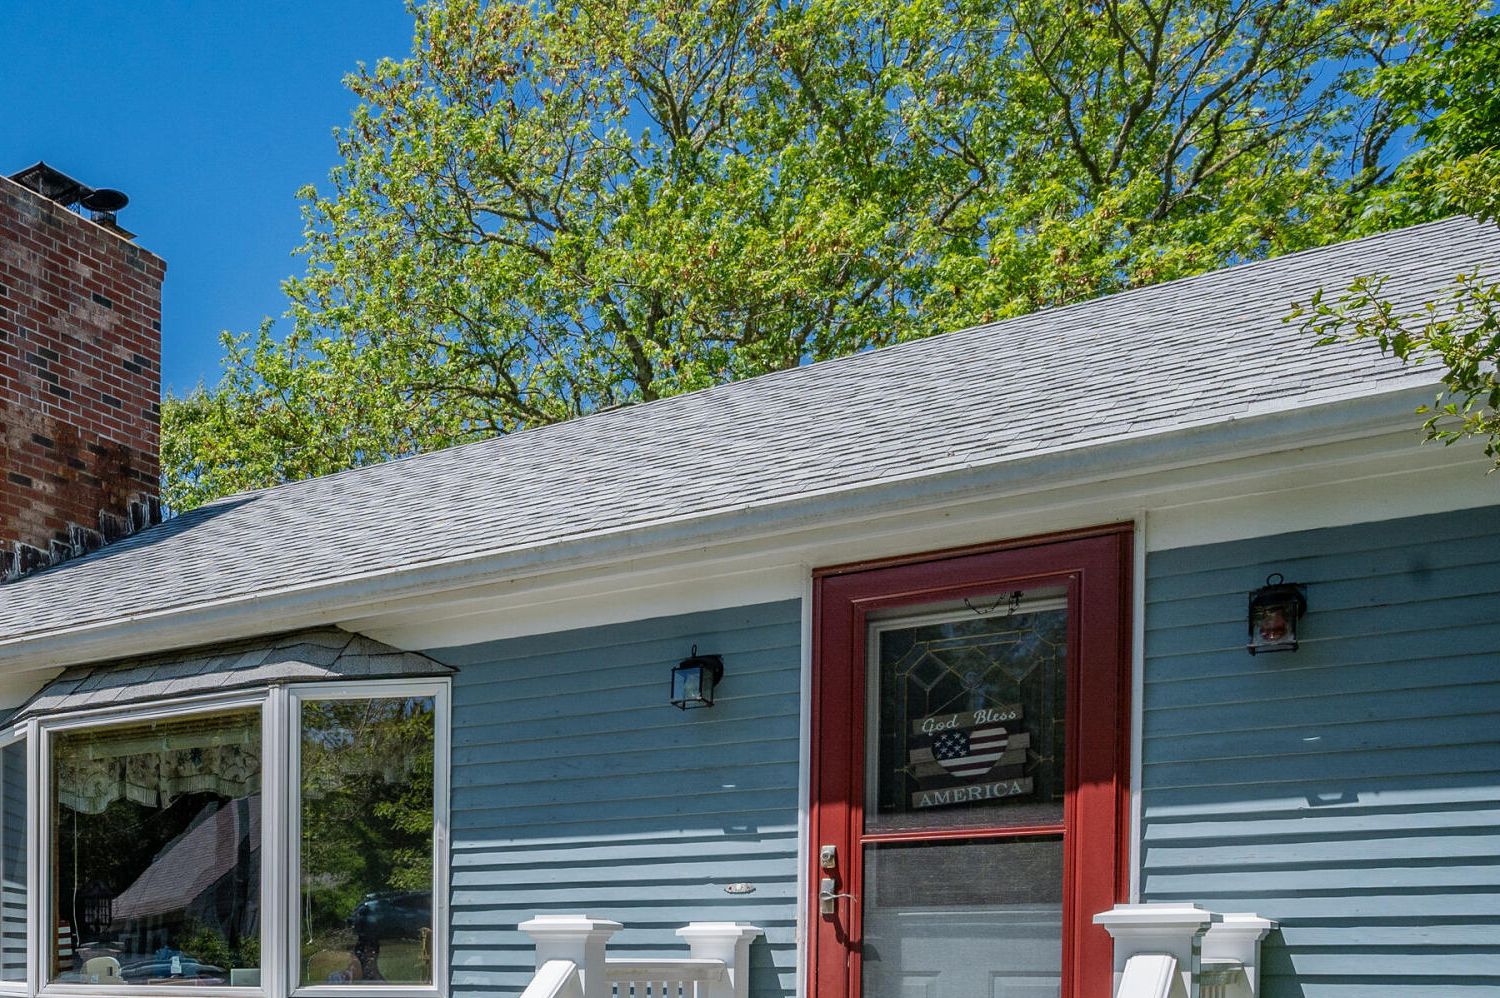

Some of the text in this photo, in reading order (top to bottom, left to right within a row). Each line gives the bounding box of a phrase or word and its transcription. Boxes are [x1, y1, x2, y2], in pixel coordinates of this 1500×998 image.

[922, 709, 1016, 736] God Bless
[920, 781, 1022, 807] AMERICA
